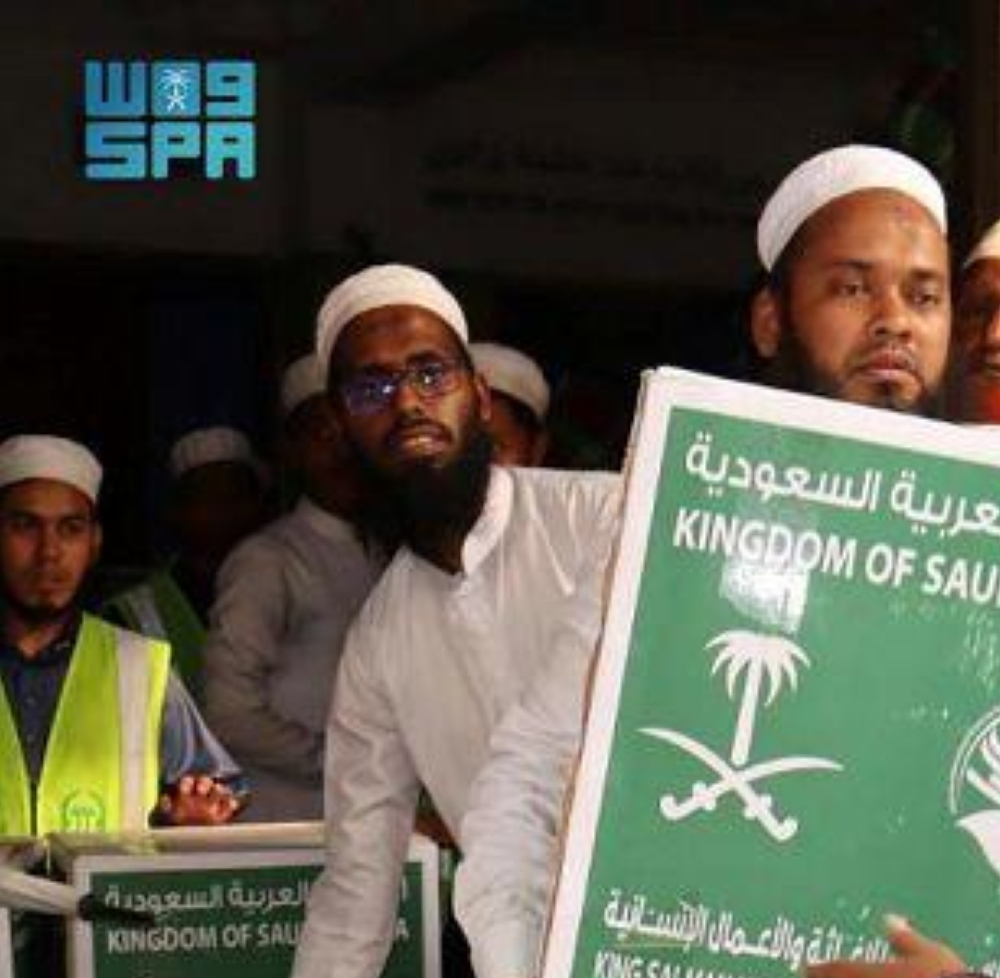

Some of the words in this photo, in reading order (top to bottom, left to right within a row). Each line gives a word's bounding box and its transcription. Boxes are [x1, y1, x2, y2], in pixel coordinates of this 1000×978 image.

[684, 432, 880, 512] السعودية
[672, 508, 856, 580] KINGDOM
[864, 544, 917, 585] OF
[107, 926, 217, 954] KINGDOM
[222, 924, 253, 948] OF
[257, 920, 301, 946] SAU
